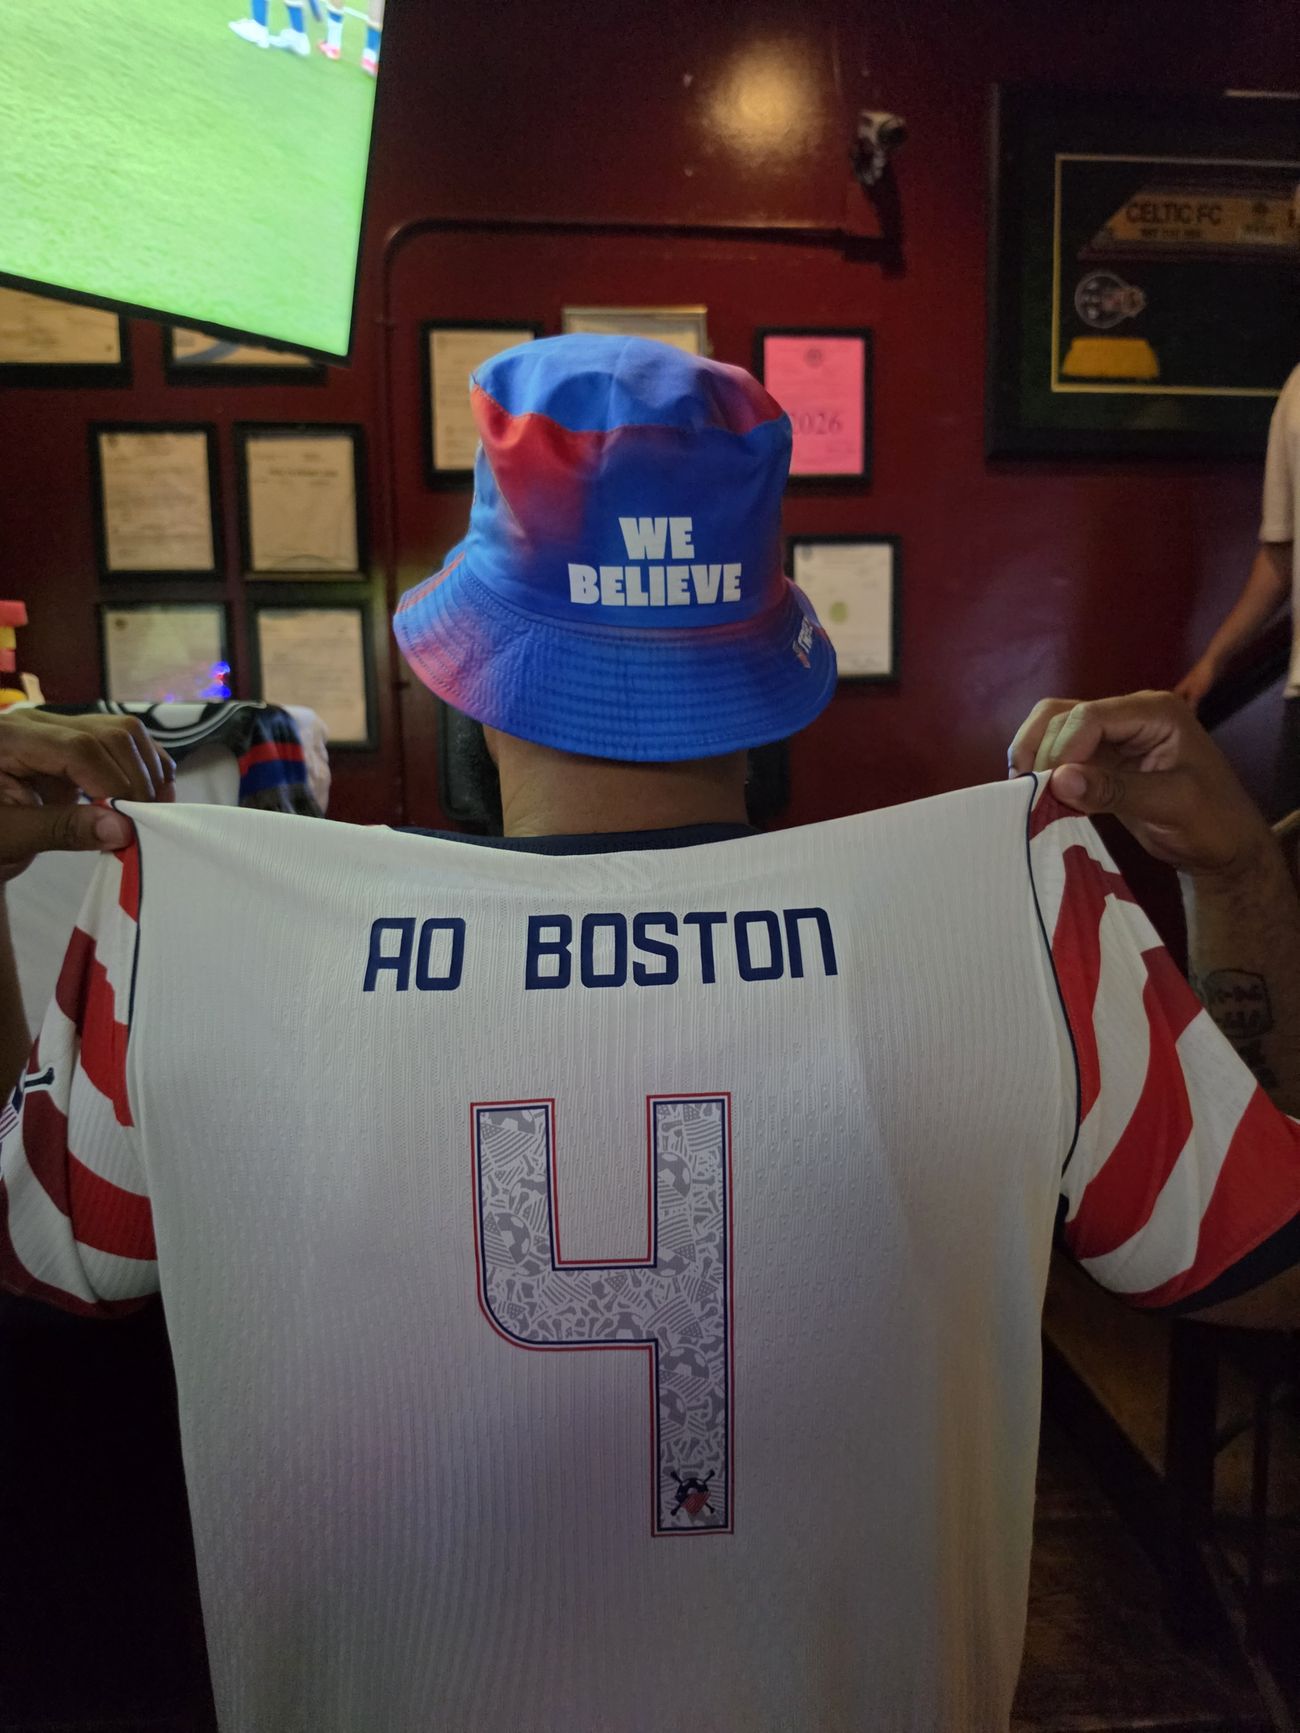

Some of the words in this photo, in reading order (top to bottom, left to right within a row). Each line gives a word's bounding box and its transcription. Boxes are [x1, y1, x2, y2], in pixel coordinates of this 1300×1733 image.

[1125, 203, 1191, 224] CELTIC
[1197, 205, 1222, 226] FC
[618, 516, 695, 560] WE
[568, 562, 742, 607] BELIEVE
[363, 917, 466, 992] AO
[525, 907, 838, 990] BOSTON
[470, 1092, 734, 1538] 4
